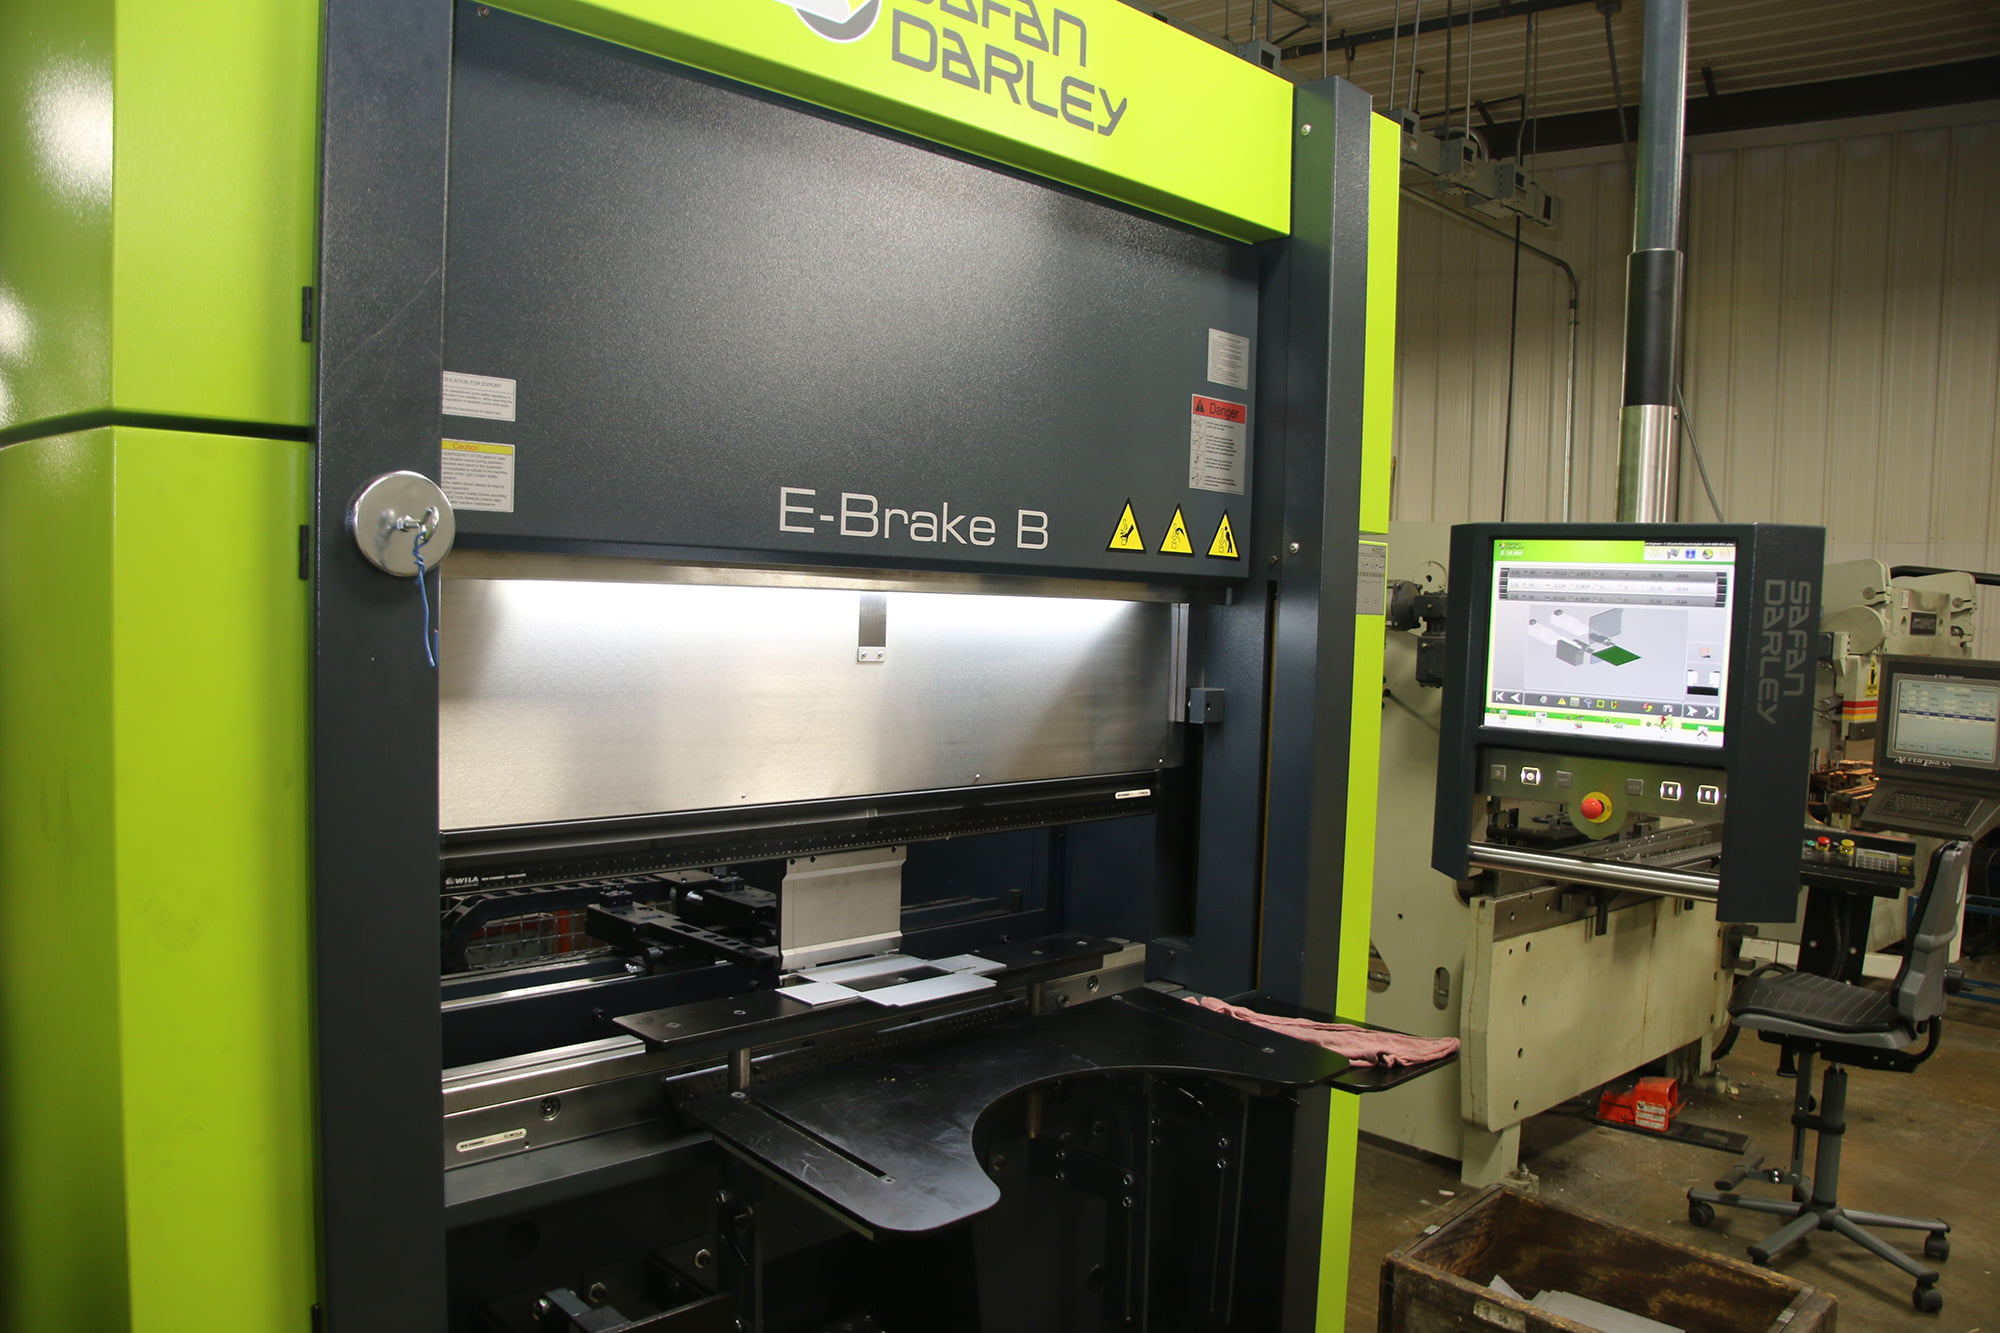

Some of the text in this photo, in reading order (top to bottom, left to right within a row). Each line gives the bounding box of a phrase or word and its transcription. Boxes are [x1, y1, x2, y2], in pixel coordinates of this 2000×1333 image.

[914, 0, 1087, 68] FAN
[1209, 402, 1239, 420] Danger
[452, 442, 480, 451] Caution
[779, 486, 1049, 551] E-Brake B
[455, 876, 479, 885] WILA
